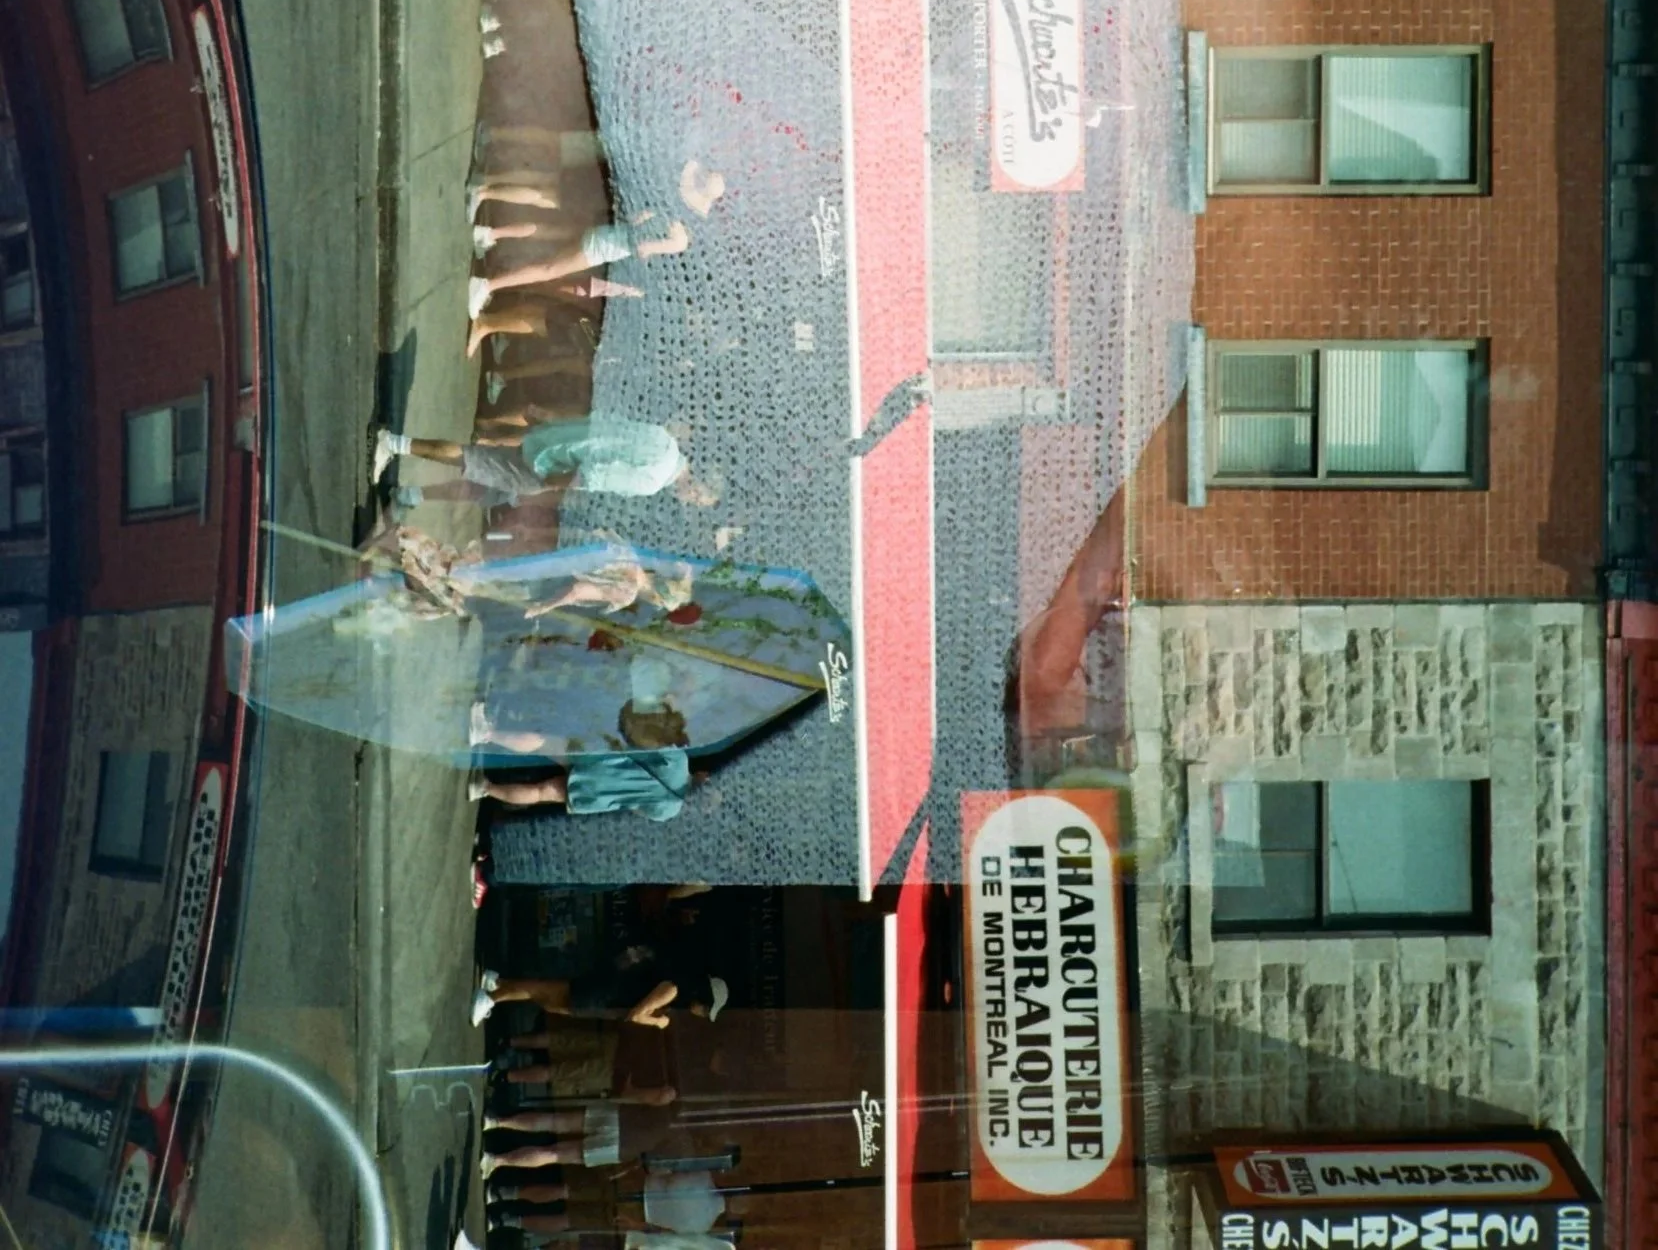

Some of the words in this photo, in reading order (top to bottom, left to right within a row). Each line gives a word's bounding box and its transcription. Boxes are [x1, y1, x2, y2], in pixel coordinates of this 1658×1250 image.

[981, 856, 1002, 897] DE
[1009, 845, 1055, 1149] HEBRAIQUE
[1056, 826, 1105, 1161] CHARCUTERIE
[987, 1088, 1010, 1147] INC.
[1320, 1162, 1540, 1188] SCHWARTZ'S
[1222, 1213, 1254, 1250] CHE
[1262, 1208, 1539, 1250] SCHWARTZ'S
[1558, 1206, 1590, 1250] CHEZ
